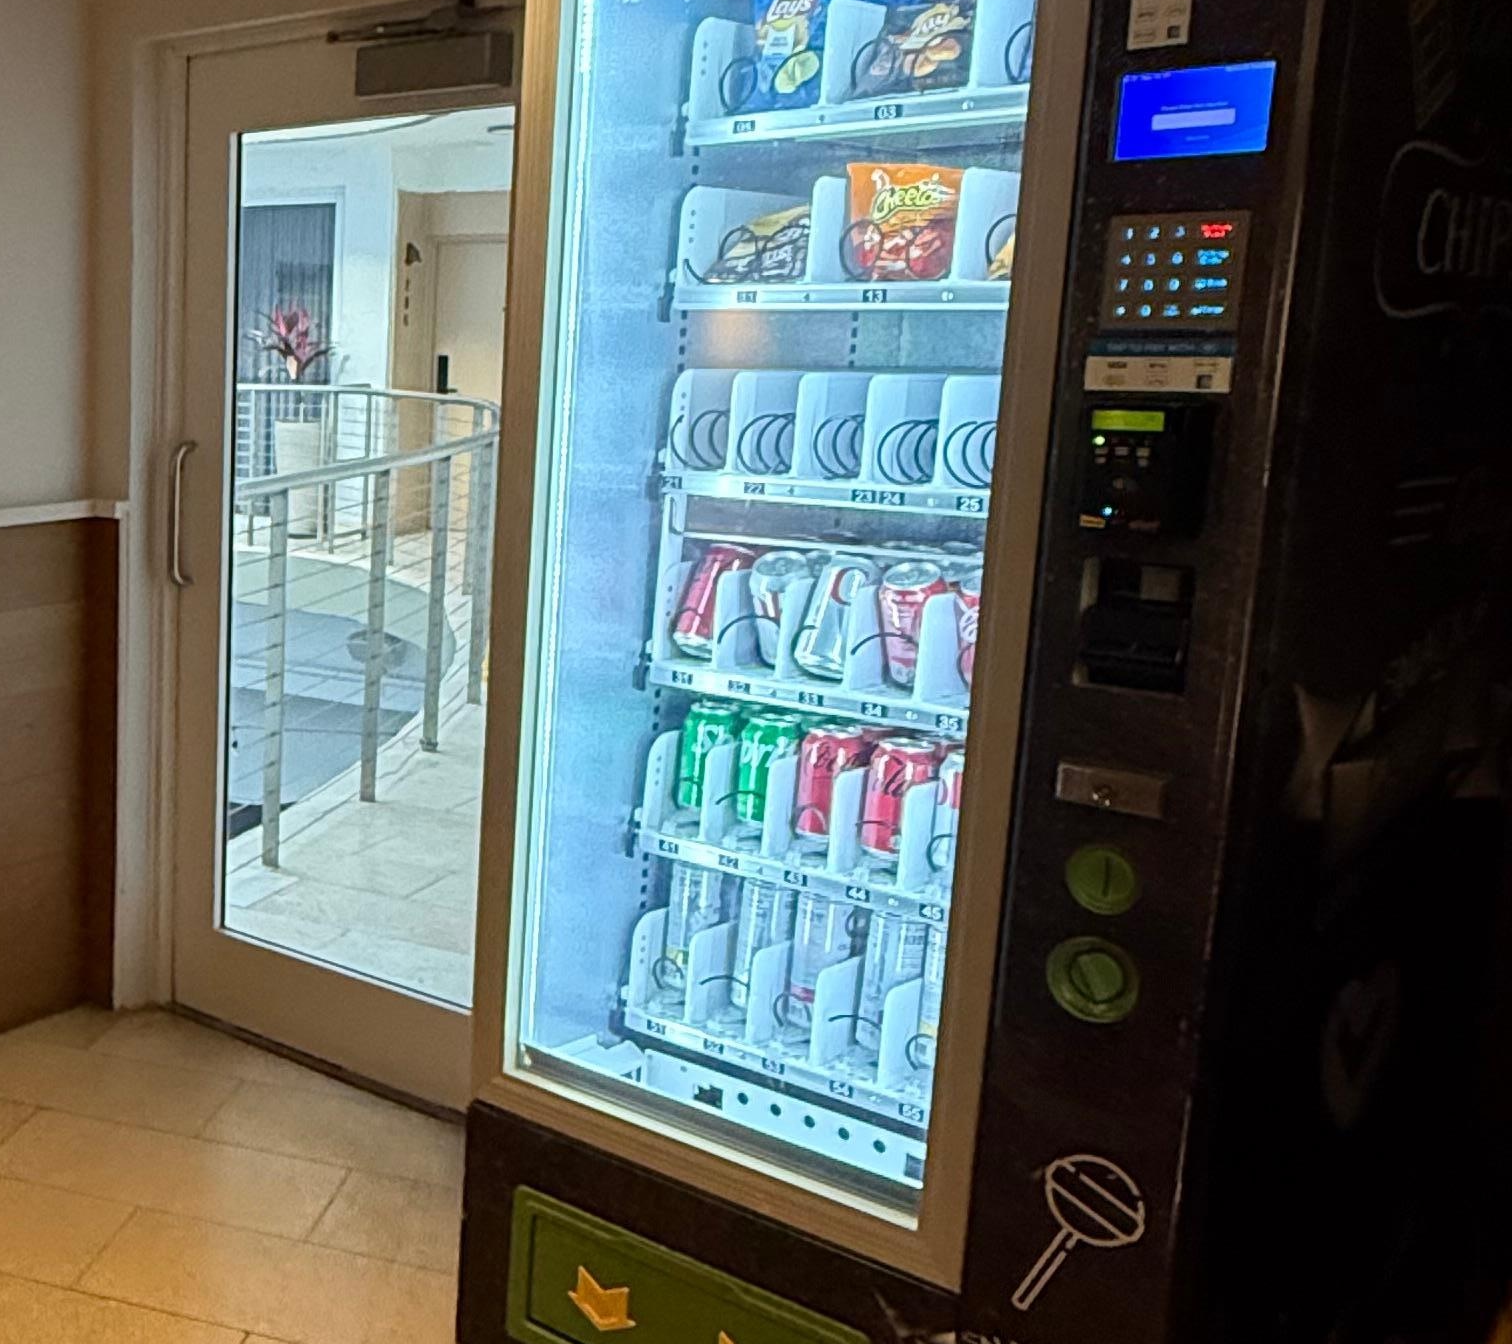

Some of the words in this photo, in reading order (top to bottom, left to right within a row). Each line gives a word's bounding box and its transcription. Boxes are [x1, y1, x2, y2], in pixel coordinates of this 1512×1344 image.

[877, 105, 897, 119] 03
[865, 289, 884, 304] 13
[854, 490, 873, 503] 23
[882, 492, 901, 505] 24
[960, 497, 981, 512] 25
[864, 702, 882, 717] 34
[939, 715, 959, 730] 35
[848, 887, 866, 901] 44
[921, 905, 943, 920] 45
